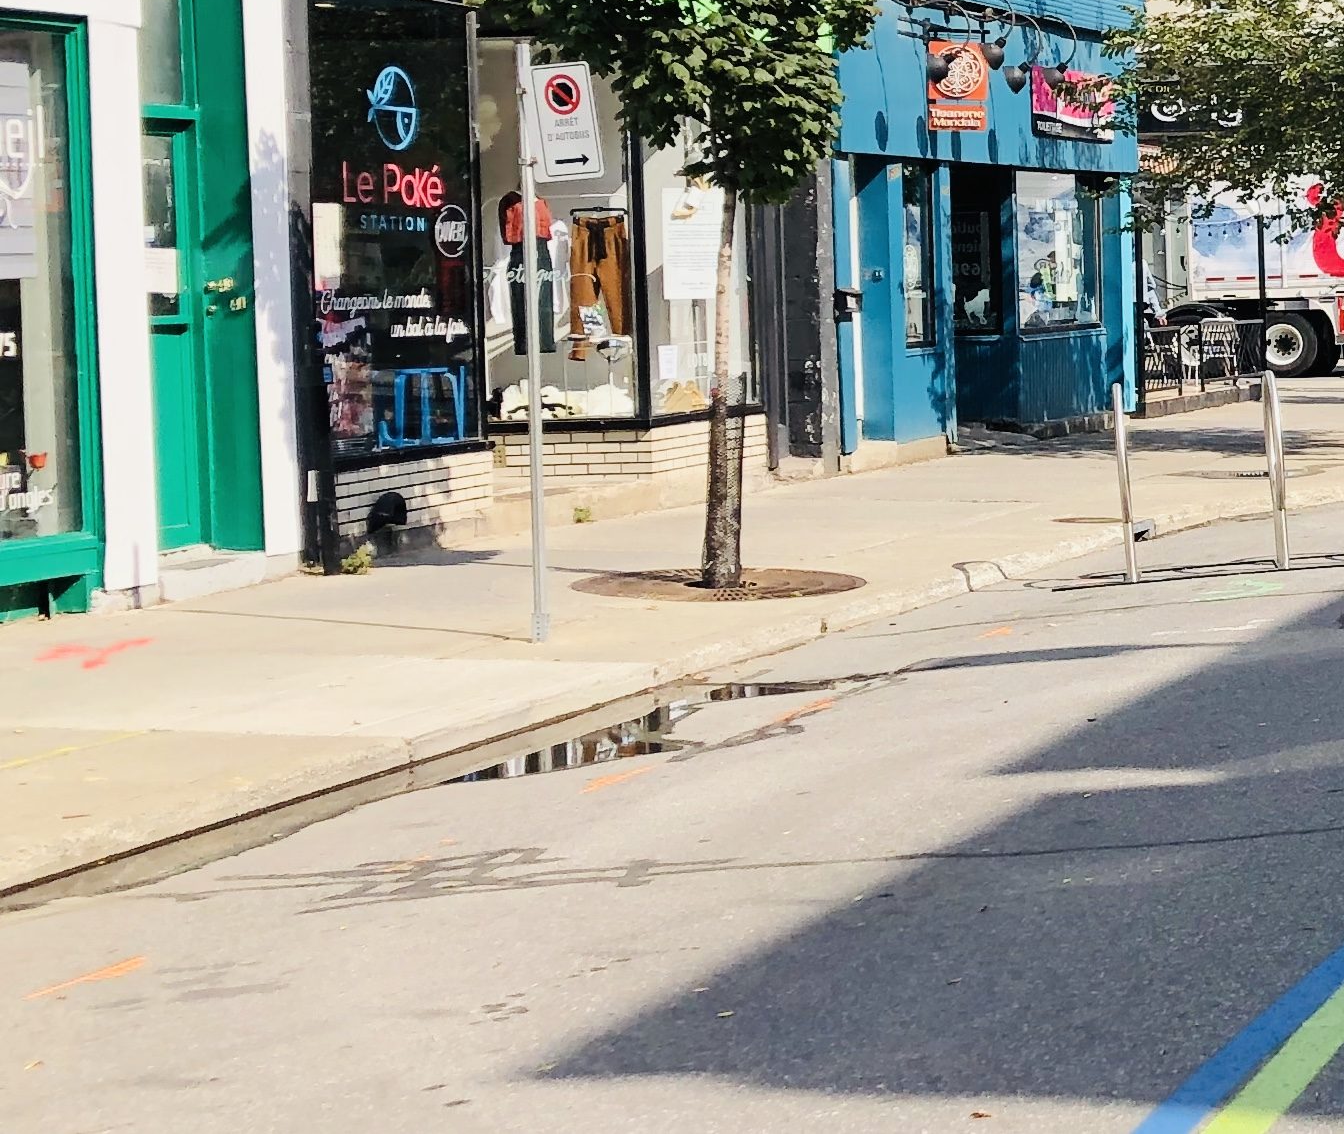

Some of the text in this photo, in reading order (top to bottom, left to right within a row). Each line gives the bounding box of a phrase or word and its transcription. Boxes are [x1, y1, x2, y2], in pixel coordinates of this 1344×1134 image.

[933, 117, 981, 128] Mandala
[341, 160, 374, 204] Le
[360, 214, 426, 232] STATION
